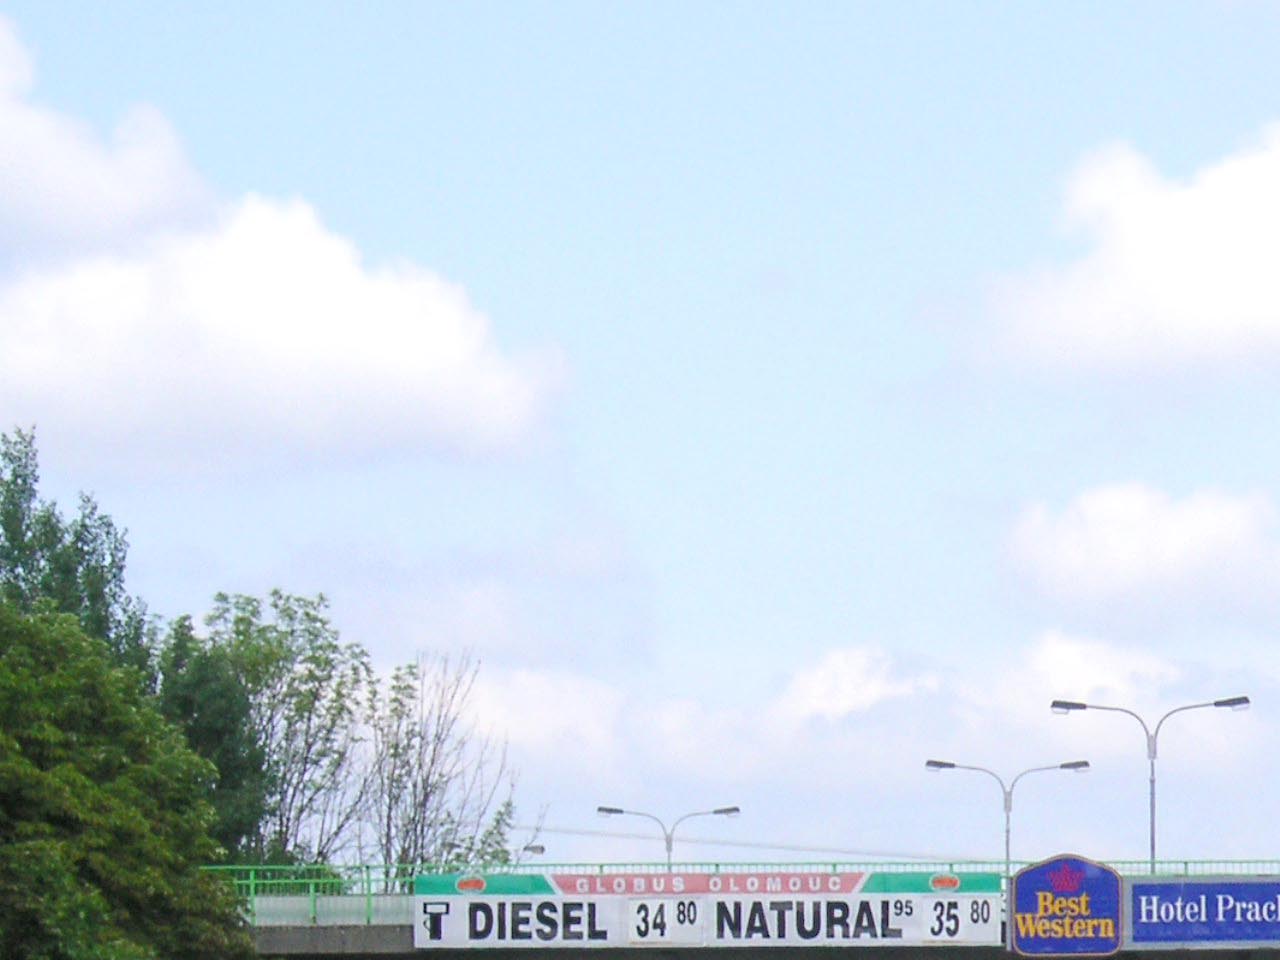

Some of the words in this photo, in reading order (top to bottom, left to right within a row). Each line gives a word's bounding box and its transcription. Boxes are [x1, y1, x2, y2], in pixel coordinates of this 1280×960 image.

[576, 875, 685, 893] GLOBUS
[709, 873, 841, 893] OLOMOUC
[1036, 891, 1091, 917] Best
[1139, 895, 1208, 924] Hotel
[468, 902, 608, 940] DIESEL
[635, 902, 667, 938] 34
[676, 901, 697, 925] 80
[716, 900, 904, 940] NATURAL
[893, 899, 914, 918] 95
[930, 900, 960, 937] 35
[970, 899, 991, 924] 80
[1015, 914, 1116, 939] Western
